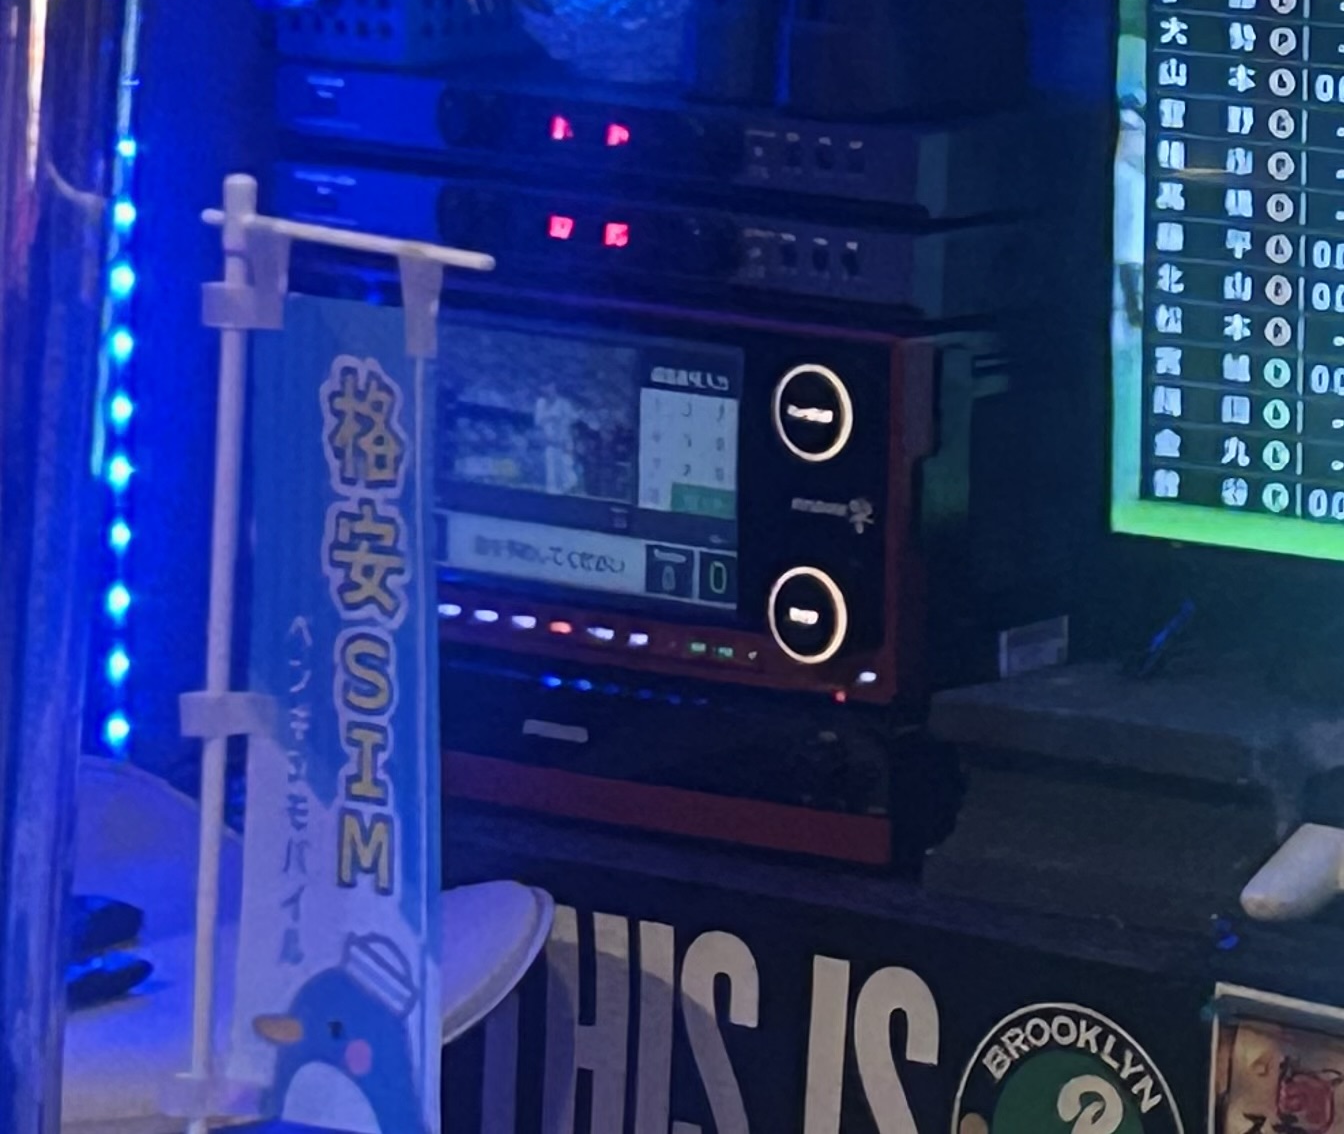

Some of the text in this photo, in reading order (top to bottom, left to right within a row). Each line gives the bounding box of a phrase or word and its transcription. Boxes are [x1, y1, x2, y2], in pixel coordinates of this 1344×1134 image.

[323, 356, 405, 898] 格安SIM
[803, 954, 940, 1134] IS
[982, 1014, 1163, 1115] BROOKLYN
